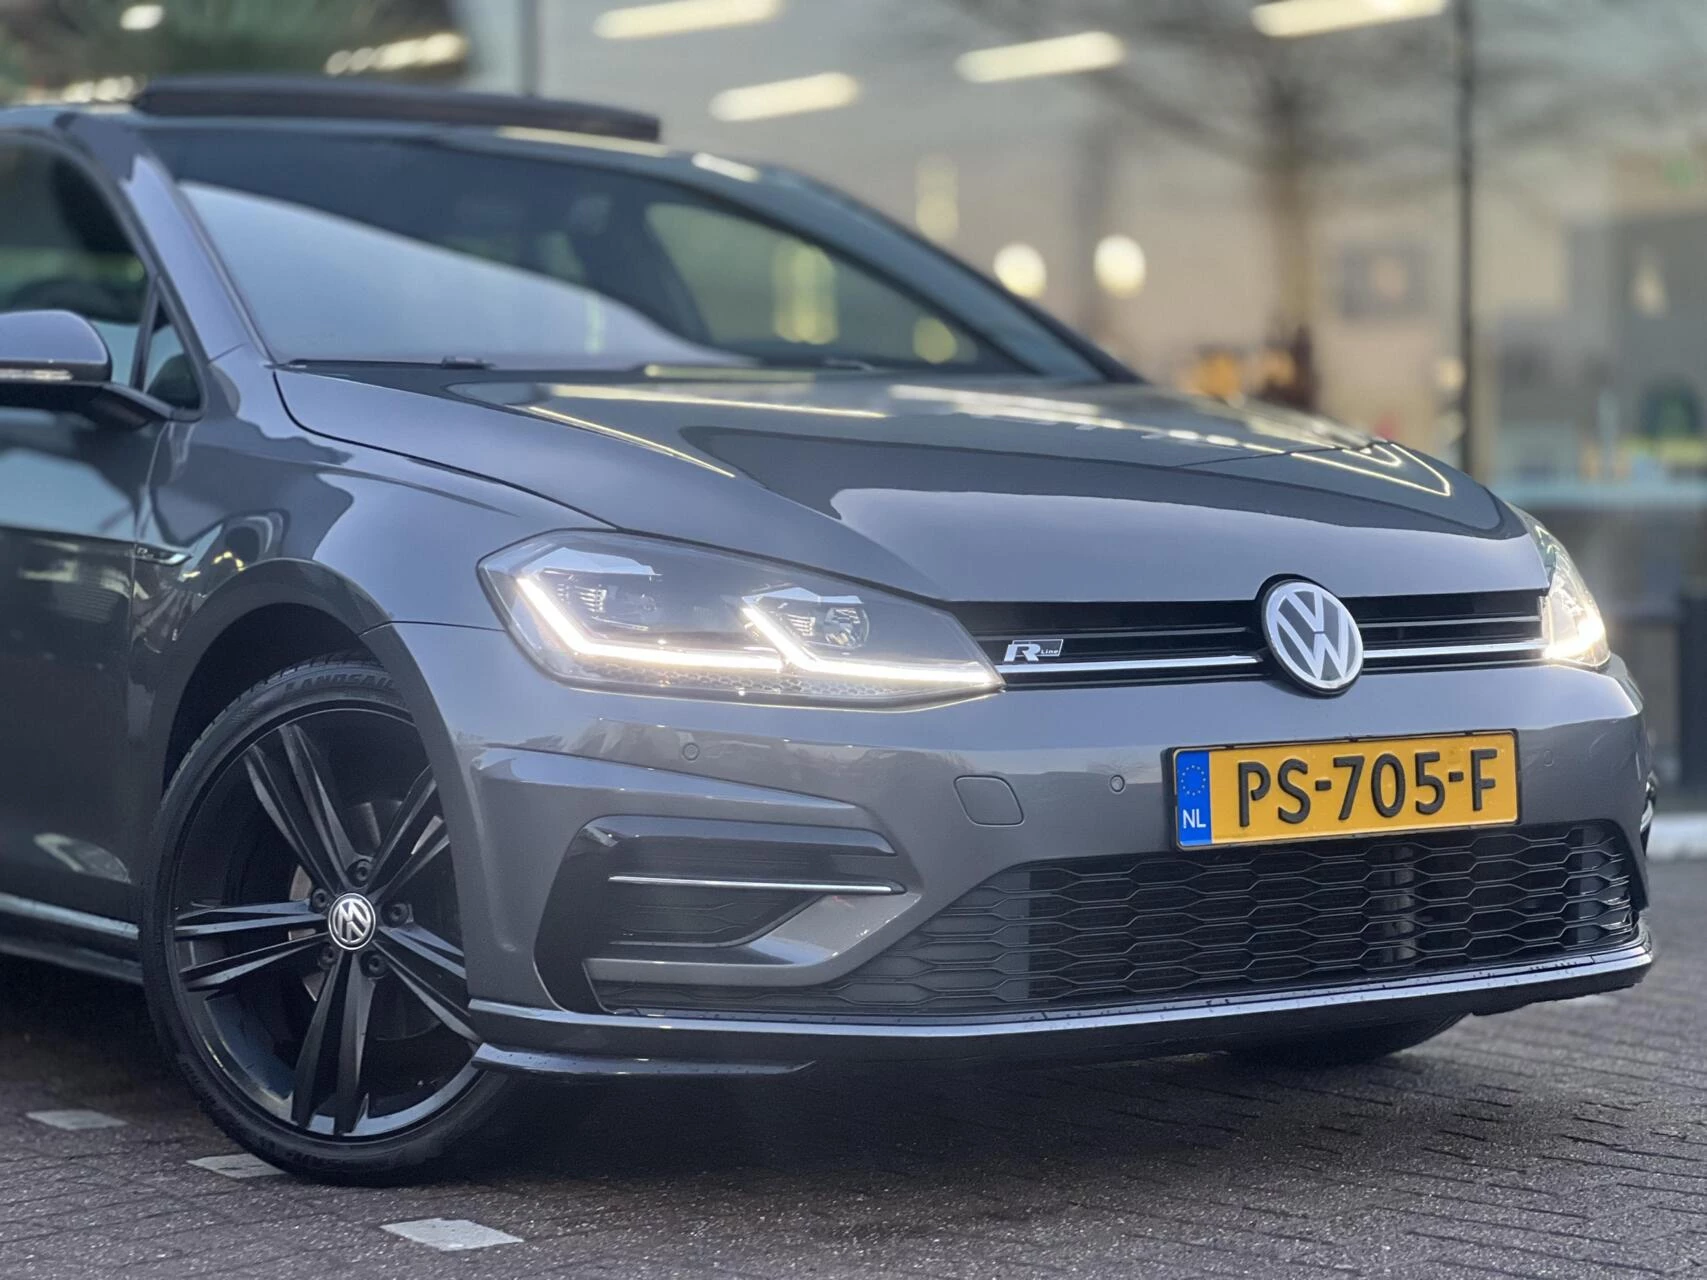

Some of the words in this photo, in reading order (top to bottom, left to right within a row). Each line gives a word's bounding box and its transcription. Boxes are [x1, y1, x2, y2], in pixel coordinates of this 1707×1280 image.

[1004, 644, 1041, 662] R
[1268, 583, 1360, 686] VW
[1237, 748, 1499, 828] PS-705-F
[1182, 809, 1207, 829] NL
